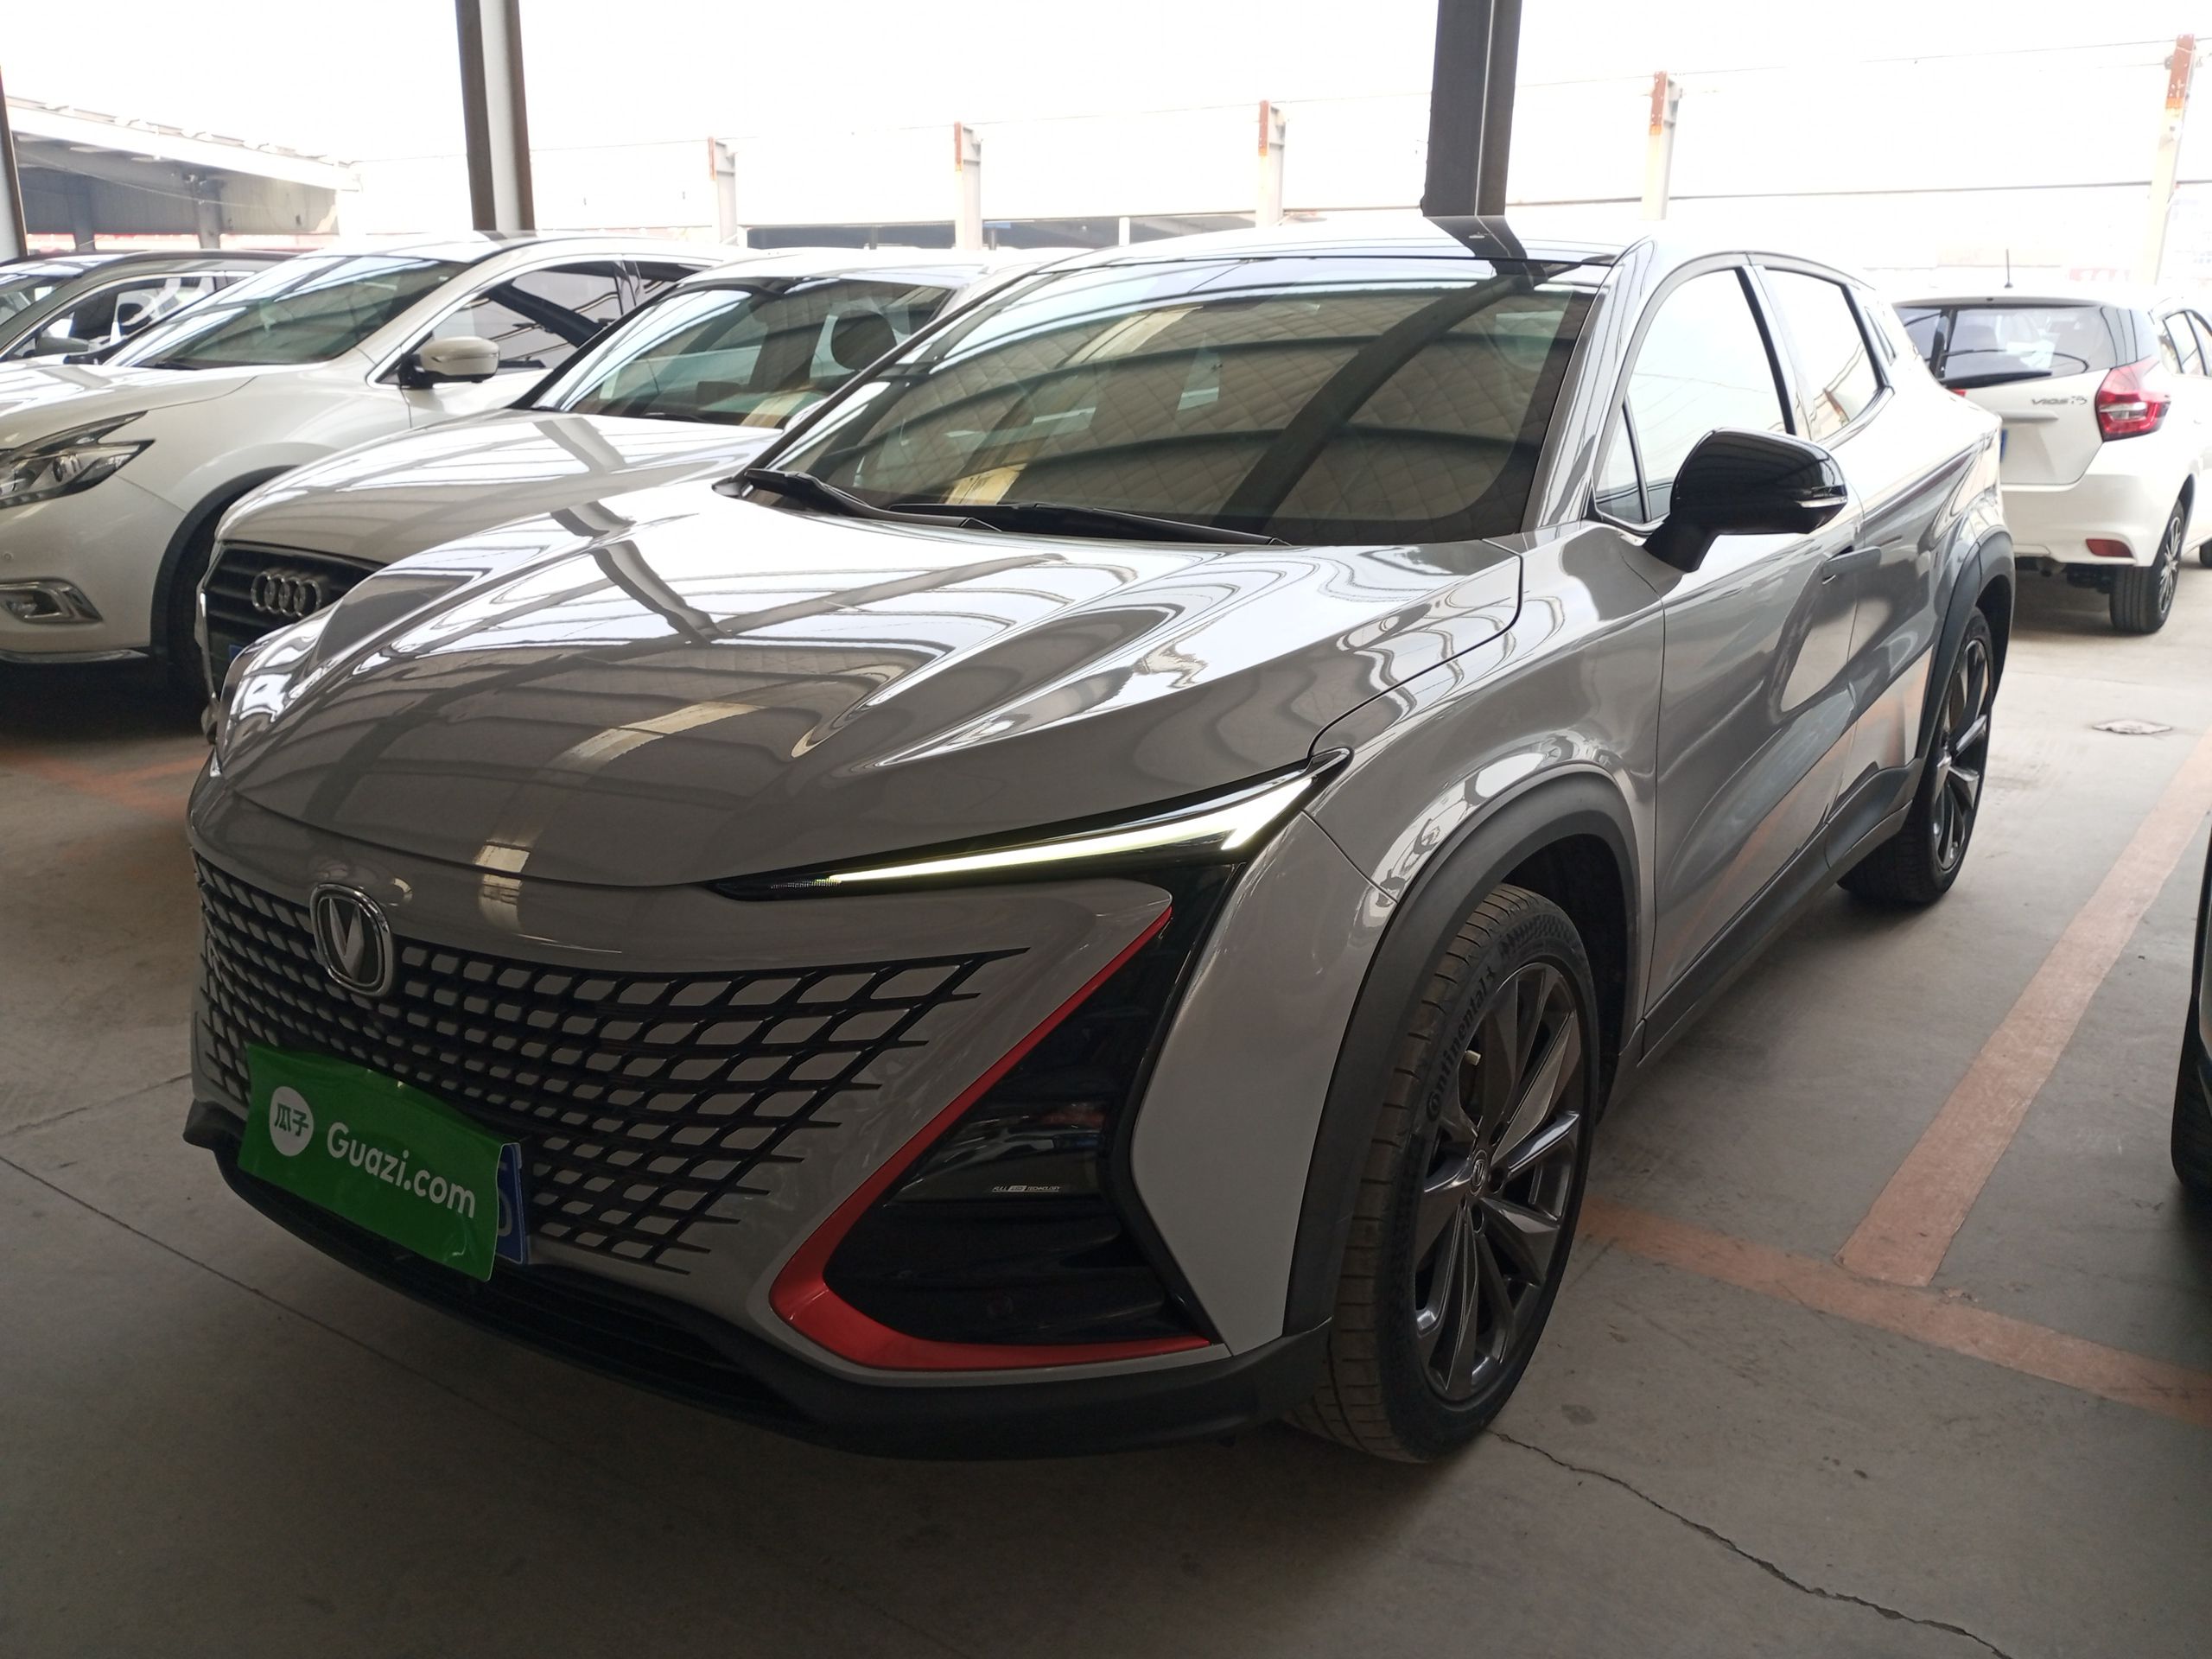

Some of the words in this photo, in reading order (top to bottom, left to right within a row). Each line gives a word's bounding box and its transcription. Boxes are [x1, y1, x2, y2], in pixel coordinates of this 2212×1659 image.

[1426, 977, 1488, 1121] Continental
[274, 1103, 310, 1137] 瓜子
[327, 1122, 476, 1219] Guazi.com
